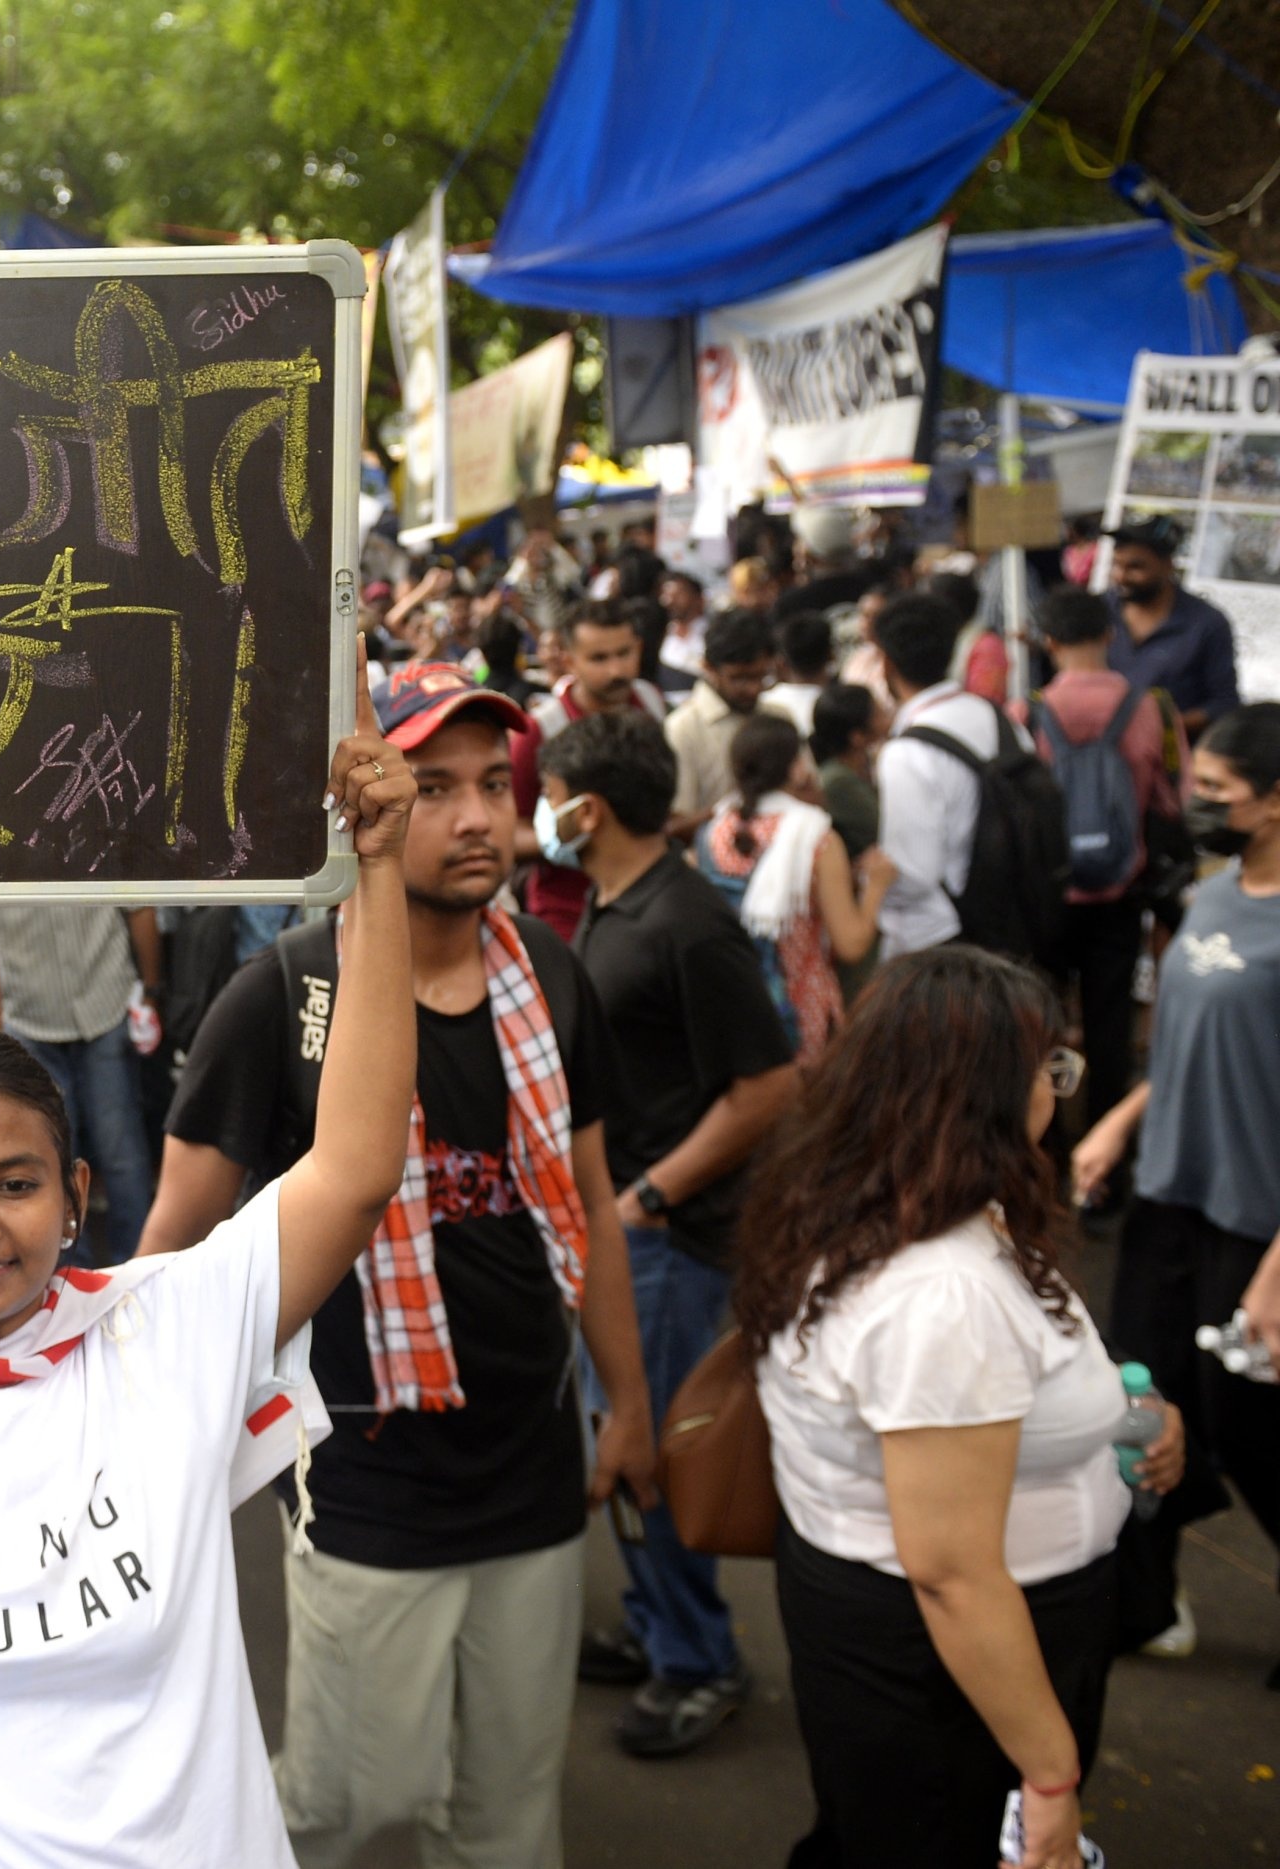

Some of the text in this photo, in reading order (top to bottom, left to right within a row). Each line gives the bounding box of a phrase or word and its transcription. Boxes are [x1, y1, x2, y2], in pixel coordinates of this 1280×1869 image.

[1145, 370, 1280, 416] WALL O
[298, 974, 332, 1063] safari
